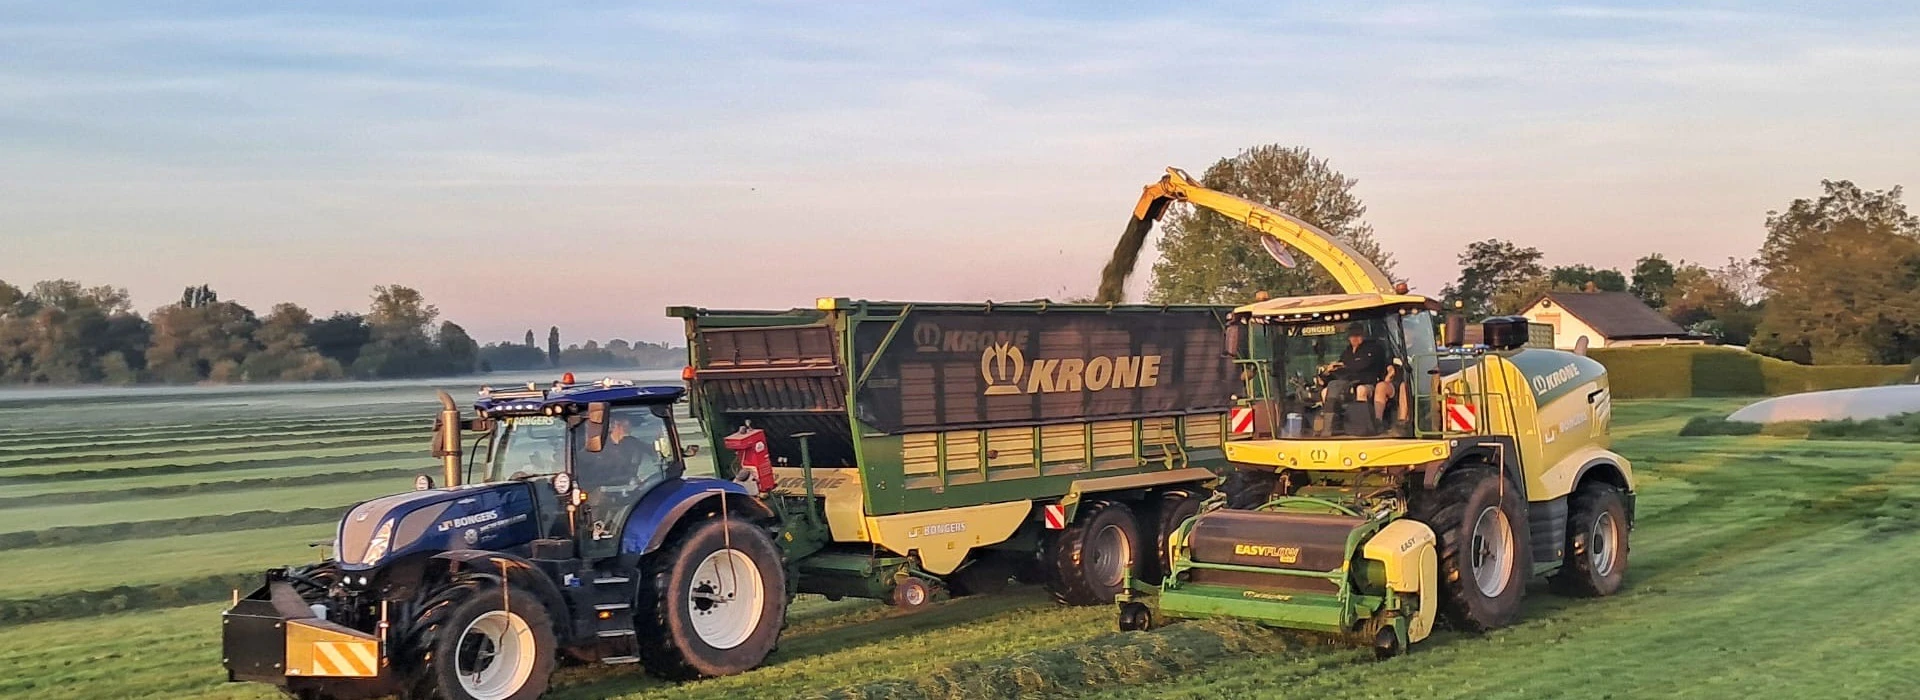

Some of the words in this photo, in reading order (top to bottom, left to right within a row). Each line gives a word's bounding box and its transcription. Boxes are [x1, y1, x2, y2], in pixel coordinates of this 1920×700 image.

[1027, 355, 1161, 394] KRONE
[1546, 363, 1580, 390] KRONE
[777, 477, 846, 489] KRNE
[454, 510, 498, 528] BONGERS
[924, 522, 966, 536] BONGERS
[1400, 537, 1416, 552] EASY
